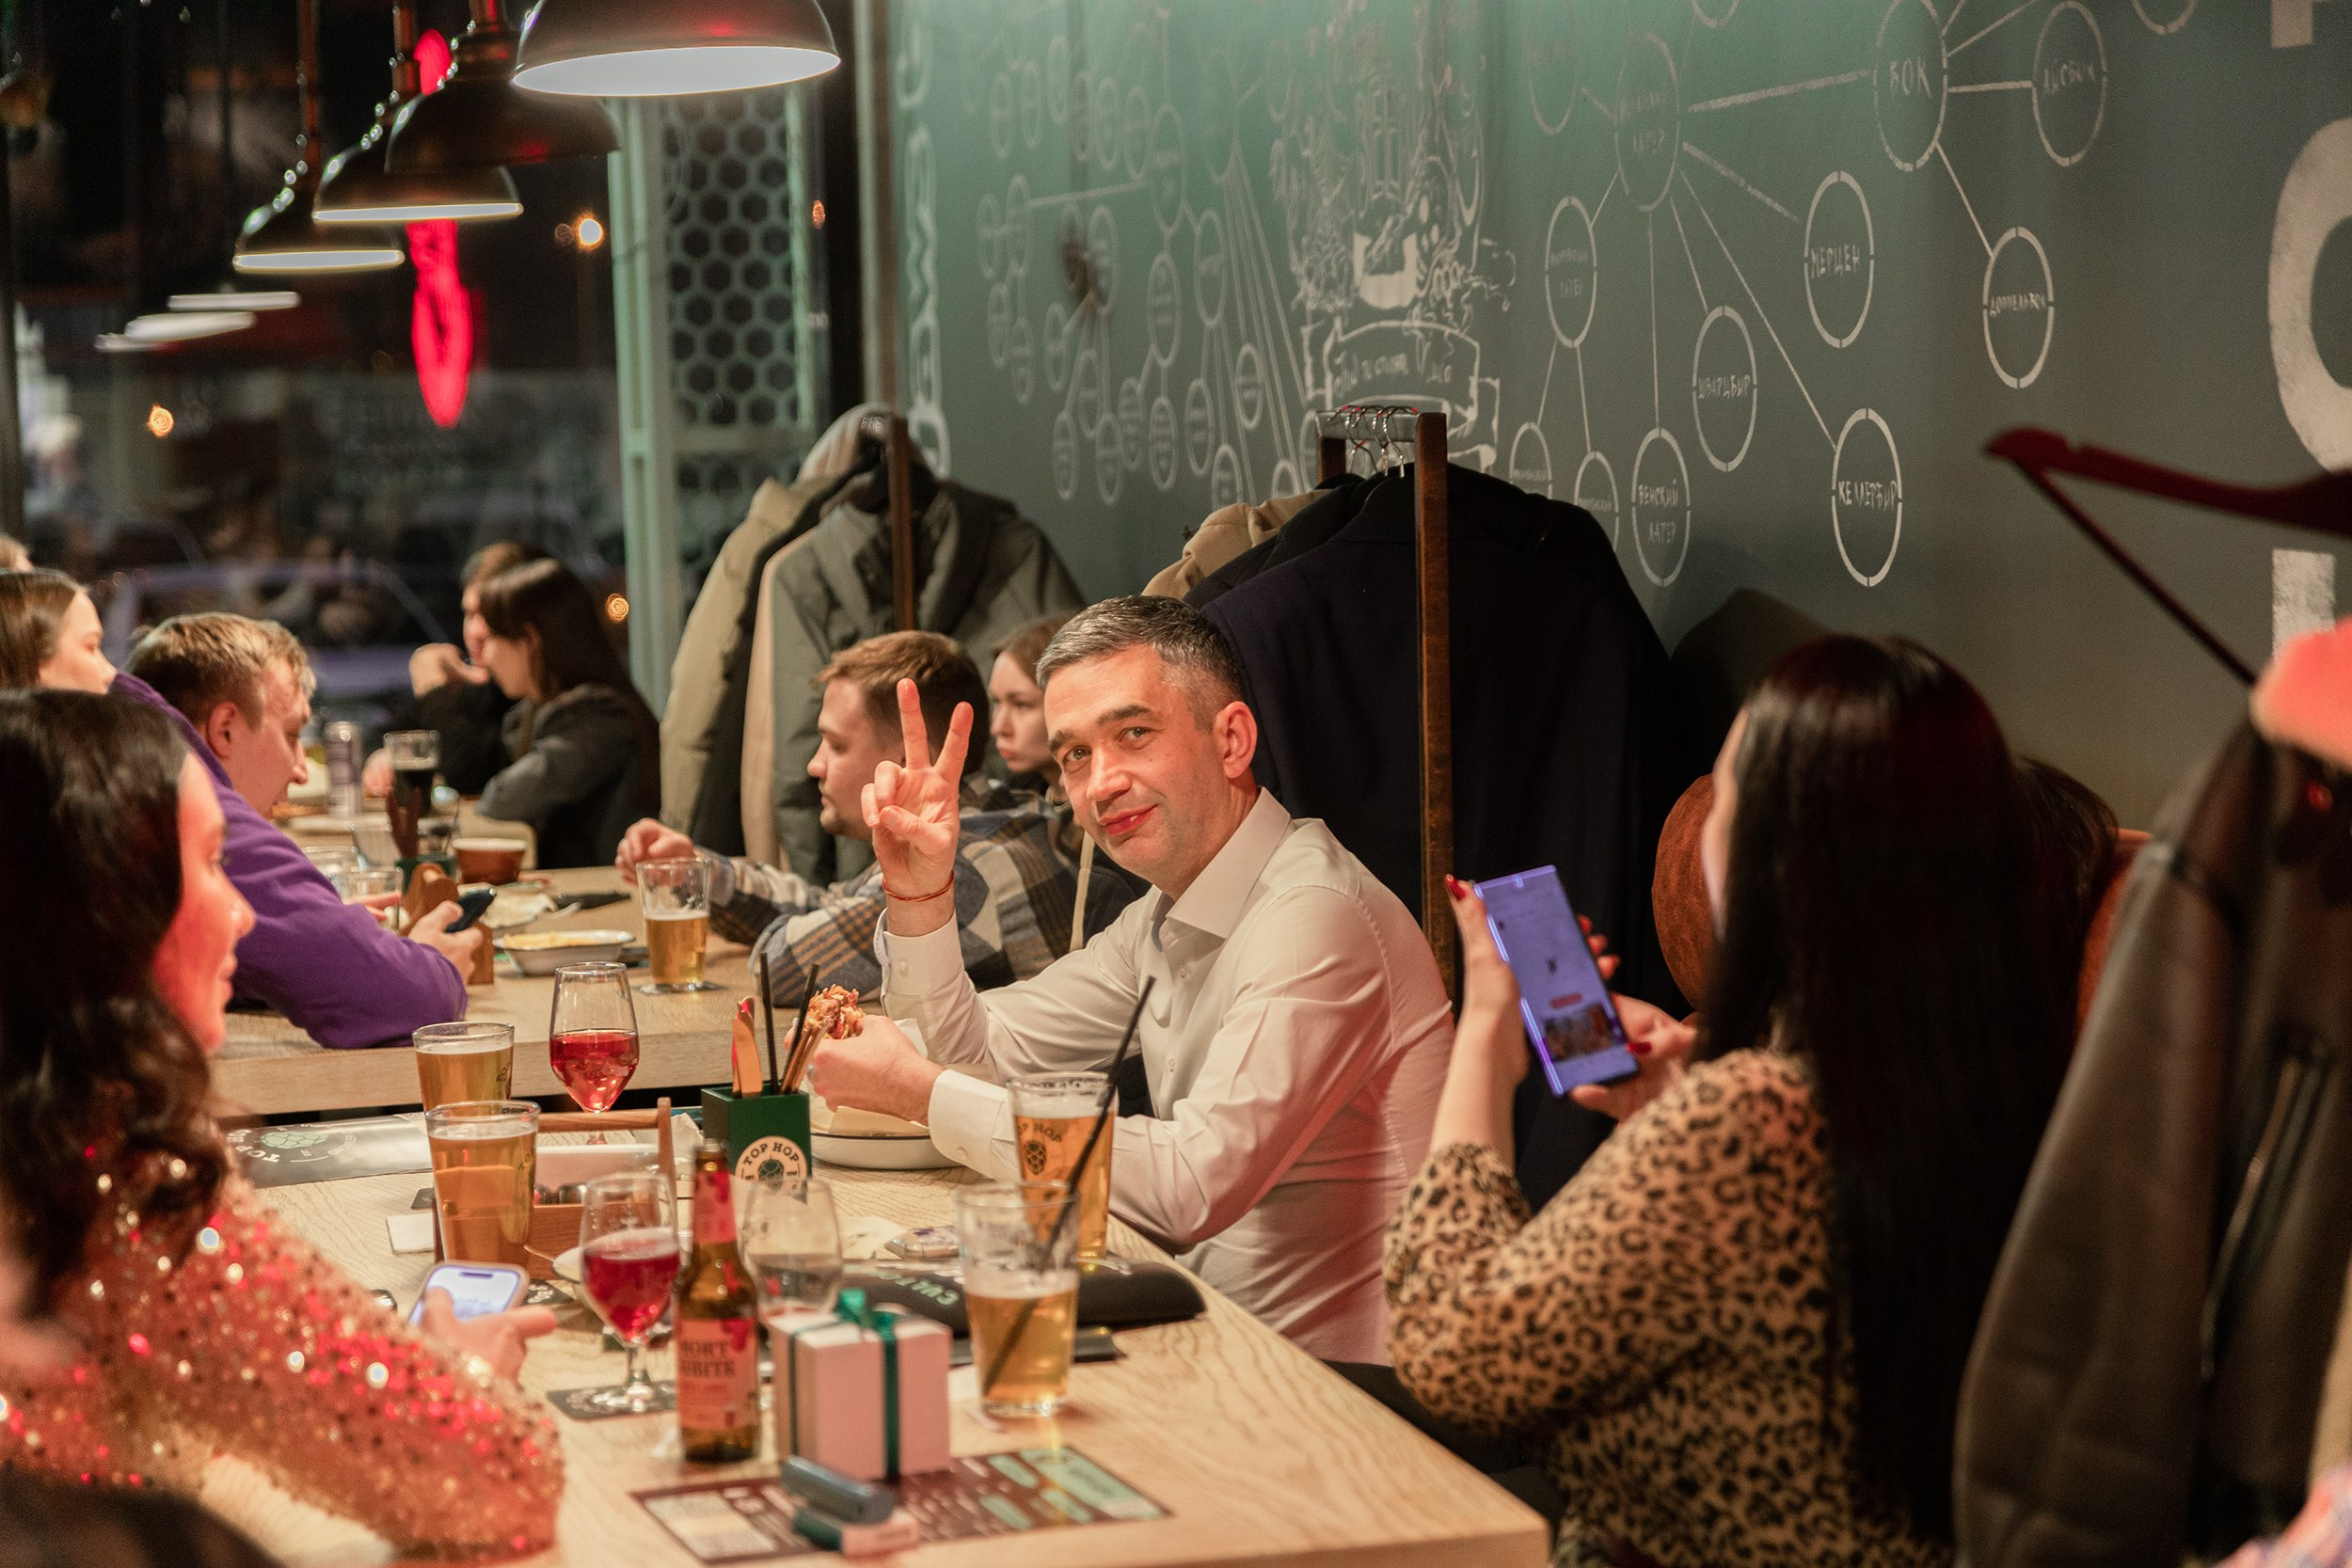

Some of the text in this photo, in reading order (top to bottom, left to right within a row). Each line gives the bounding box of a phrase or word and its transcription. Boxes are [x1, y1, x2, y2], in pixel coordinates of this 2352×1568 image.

[1889, 56, 1931, 99] БОК
[1810, 243, 1860, 278] МЕРЦЕН
[1698, 374, 1751, 399] ШВАРЦБИР
[1637, 478, 1679, 509] ВЕНСКИЙ
[235, 1145, 280, 1163] TOP
[743, 1142, 799, 1165] TOP HOP
